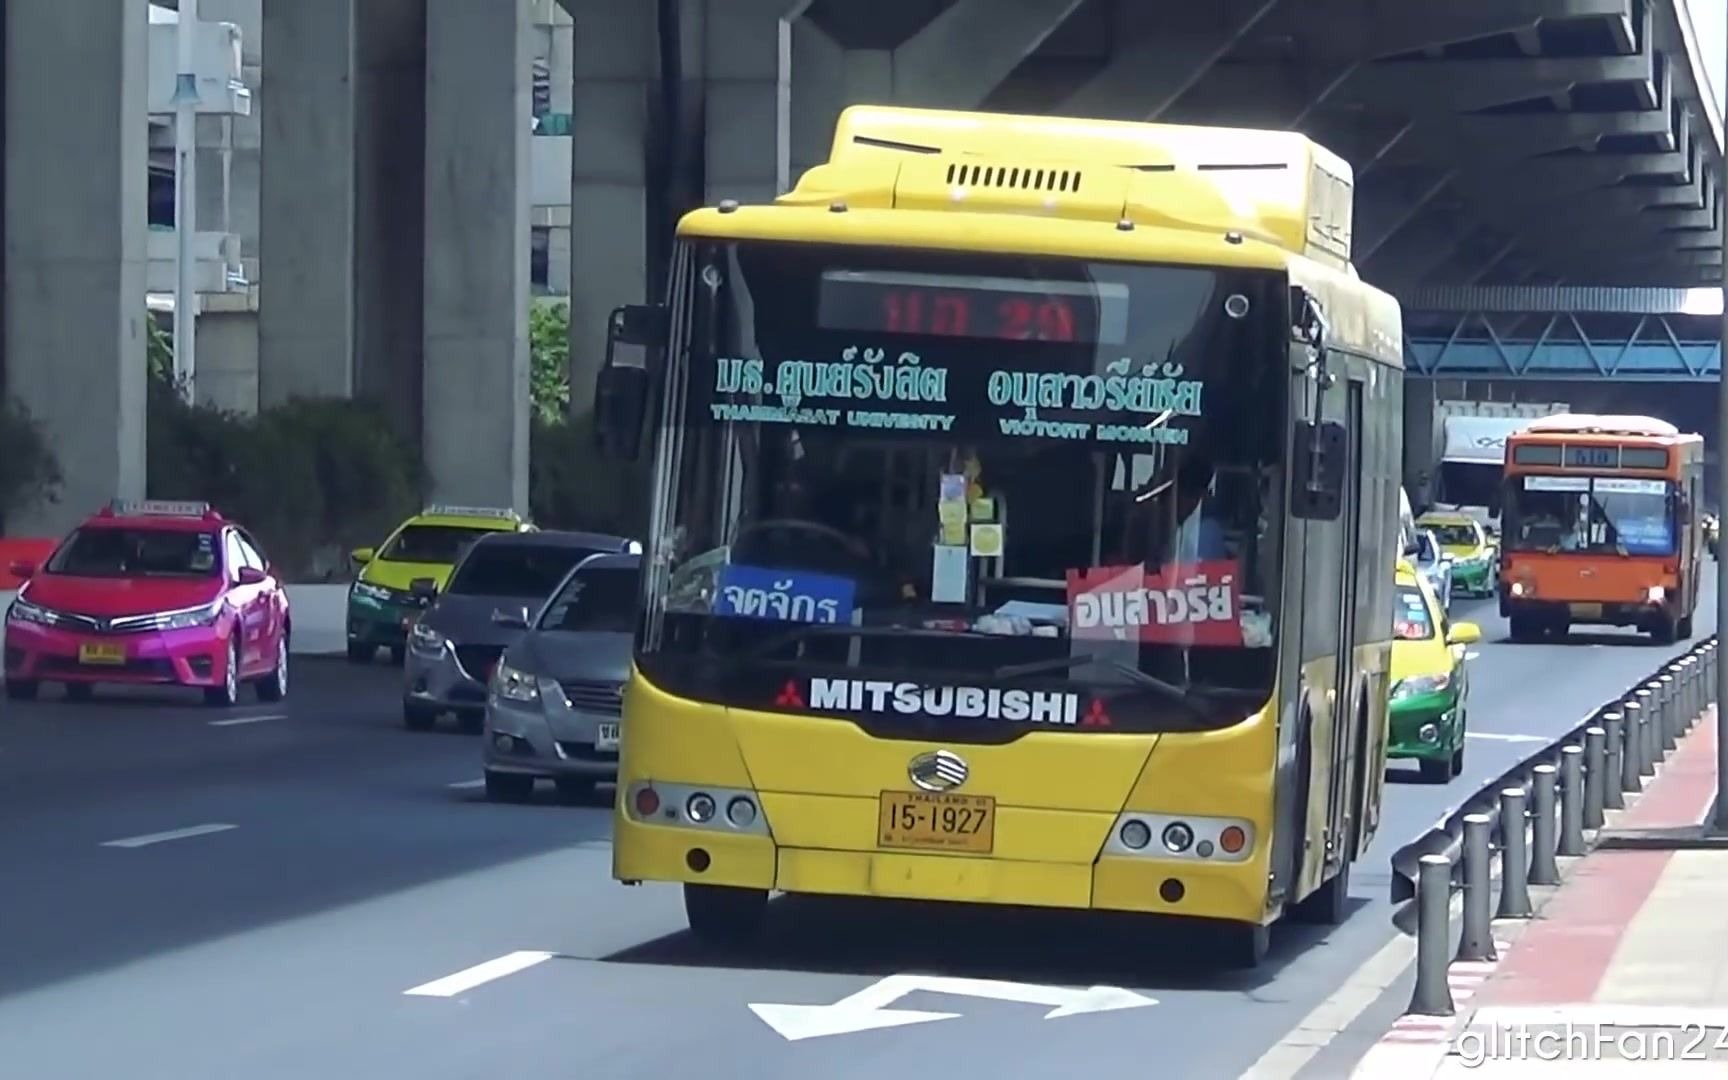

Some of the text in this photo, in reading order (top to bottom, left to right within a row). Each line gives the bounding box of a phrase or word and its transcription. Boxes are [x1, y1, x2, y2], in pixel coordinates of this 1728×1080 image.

[1075, 574, 1233, 641] อนุสาวรีย์
[809, 677, 1078, 725] MITSUBISHI
[890, 802, 987, 835] 15-1927
